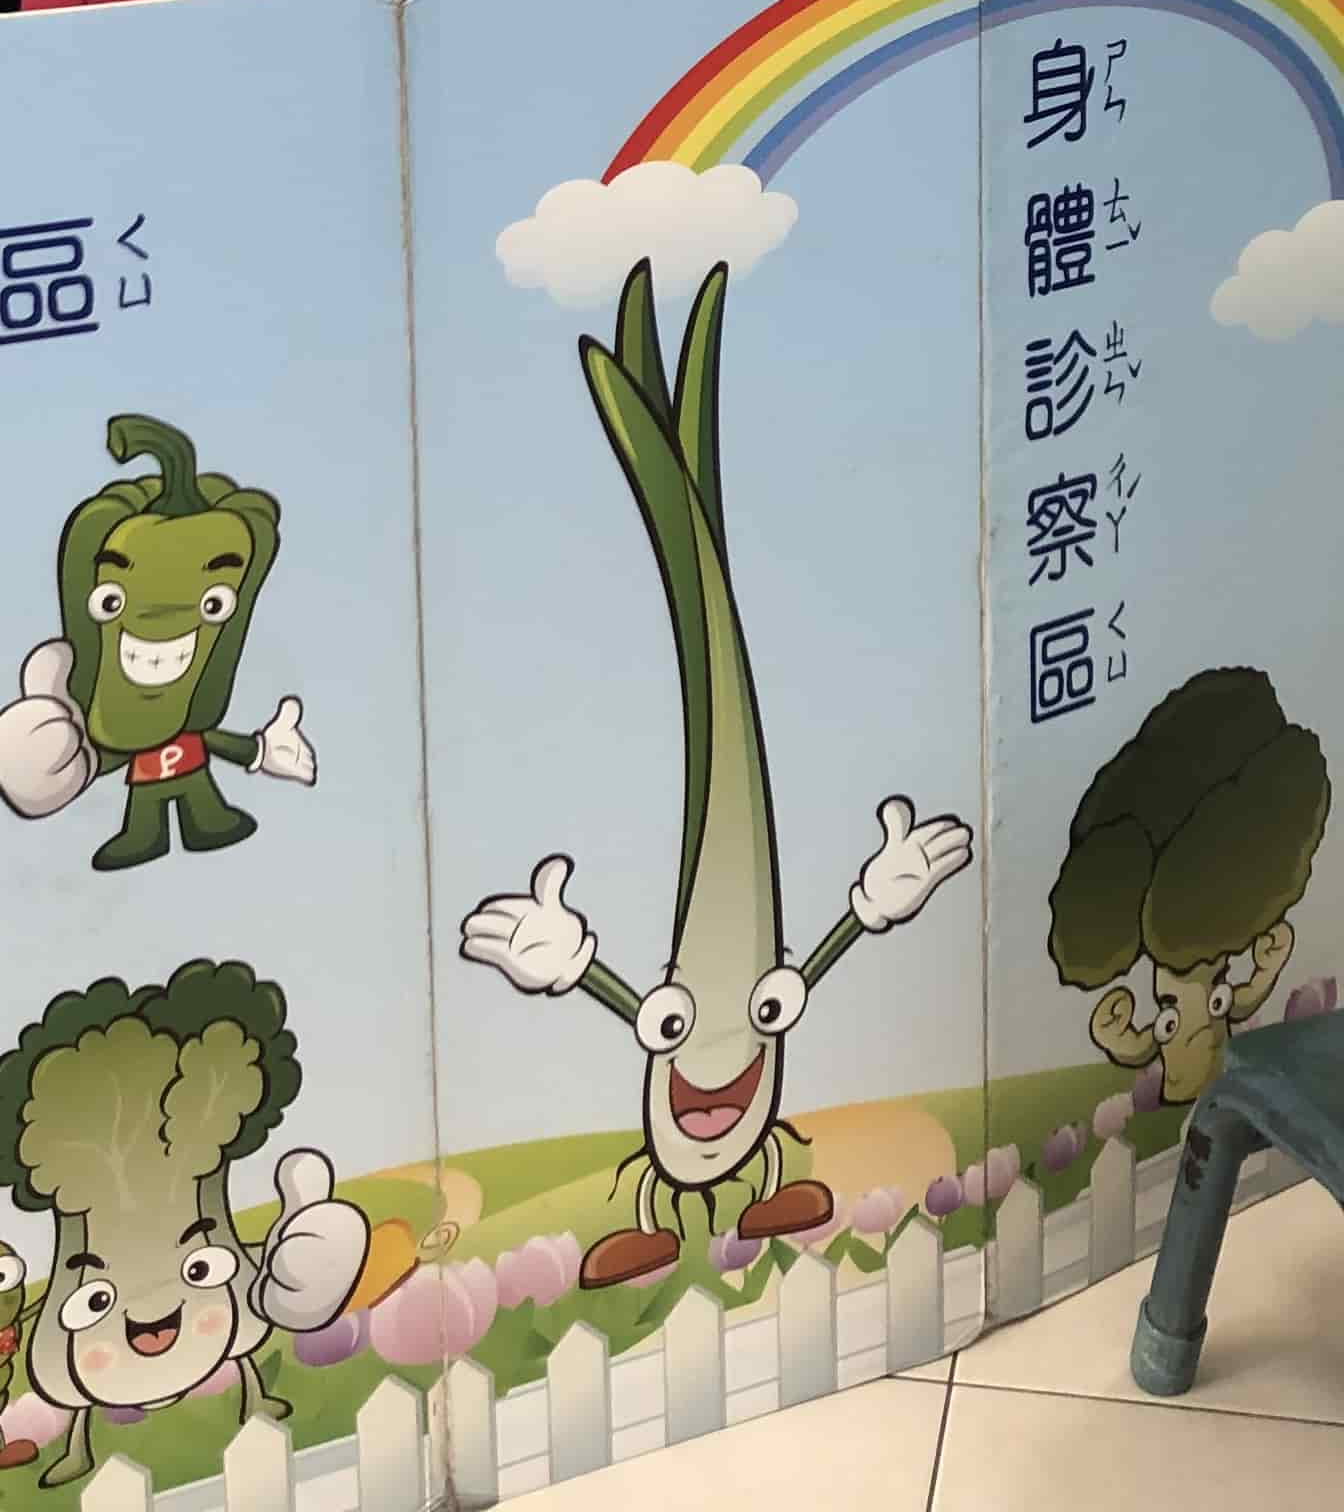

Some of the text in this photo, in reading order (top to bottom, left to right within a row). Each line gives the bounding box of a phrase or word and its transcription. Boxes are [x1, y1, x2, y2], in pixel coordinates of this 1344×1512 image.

[1023, 38, 1097, 724] 身體診察區
